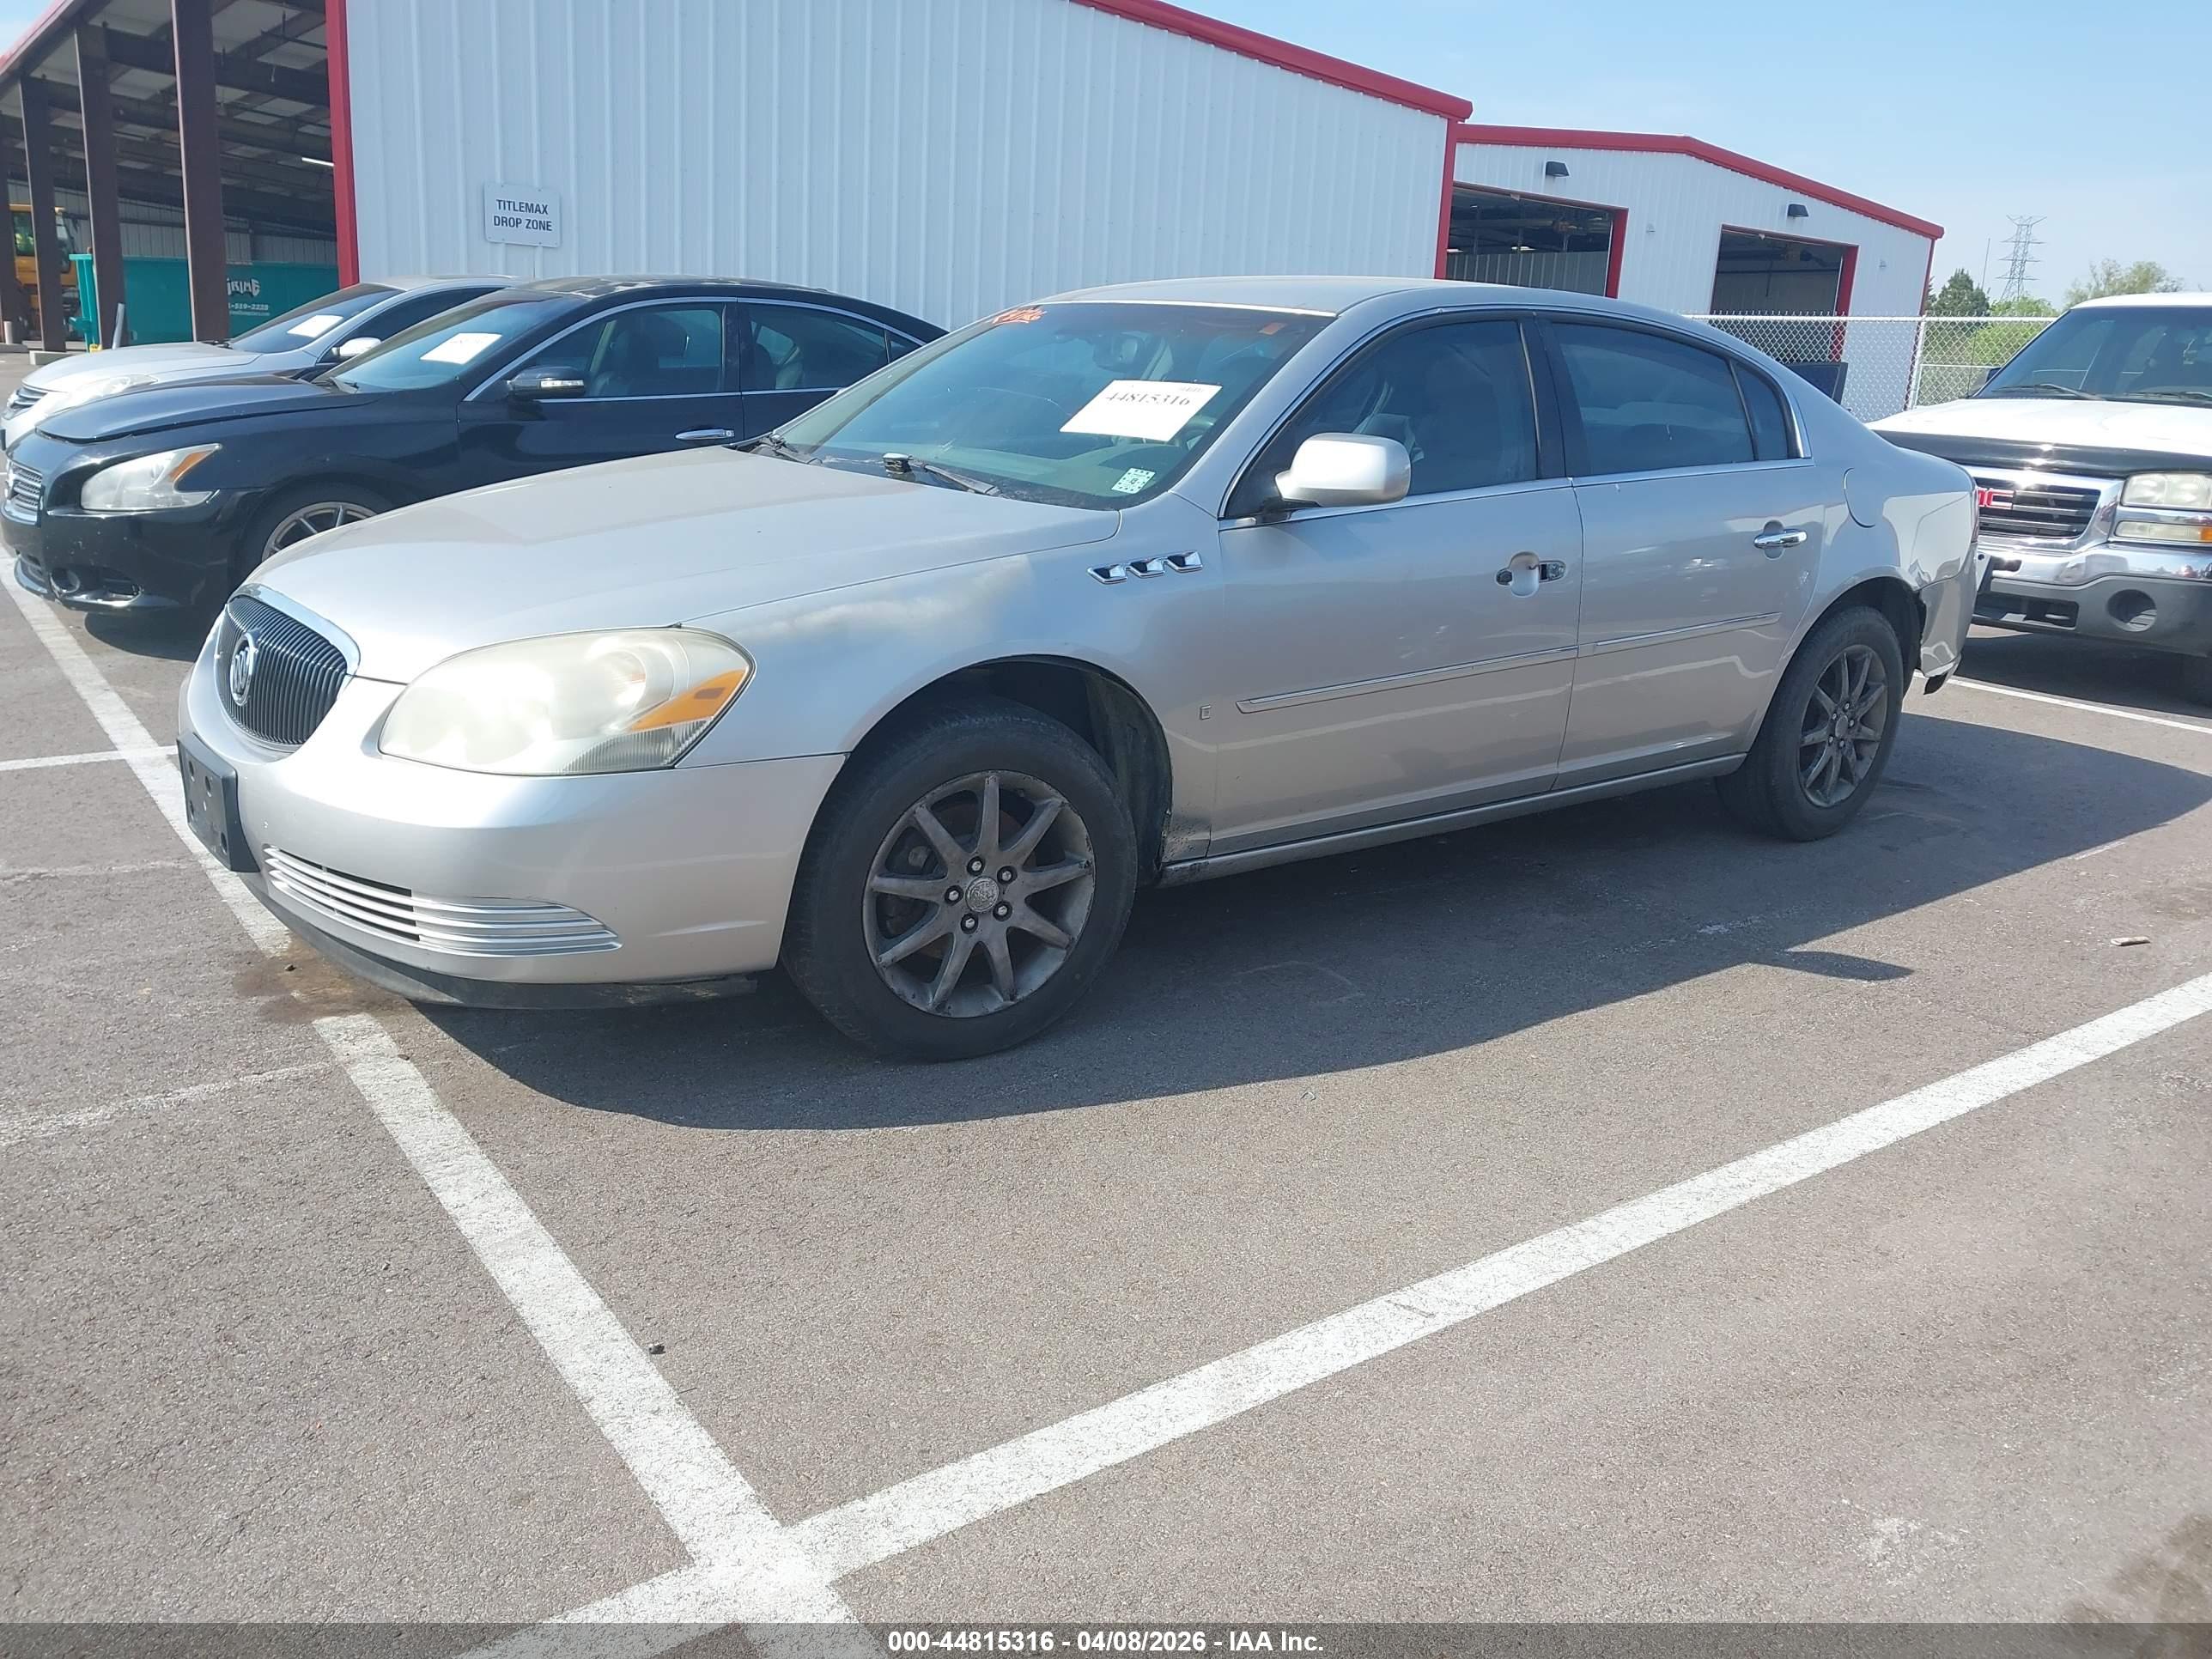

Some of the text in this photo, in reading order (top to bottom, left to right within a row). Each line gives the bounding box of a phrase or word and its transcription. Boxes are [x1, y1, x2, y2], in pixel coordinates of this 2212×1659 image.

[496, 198, 549, 216] TITLEMAX
[494, 215, 553, 232] DROP ZONE
